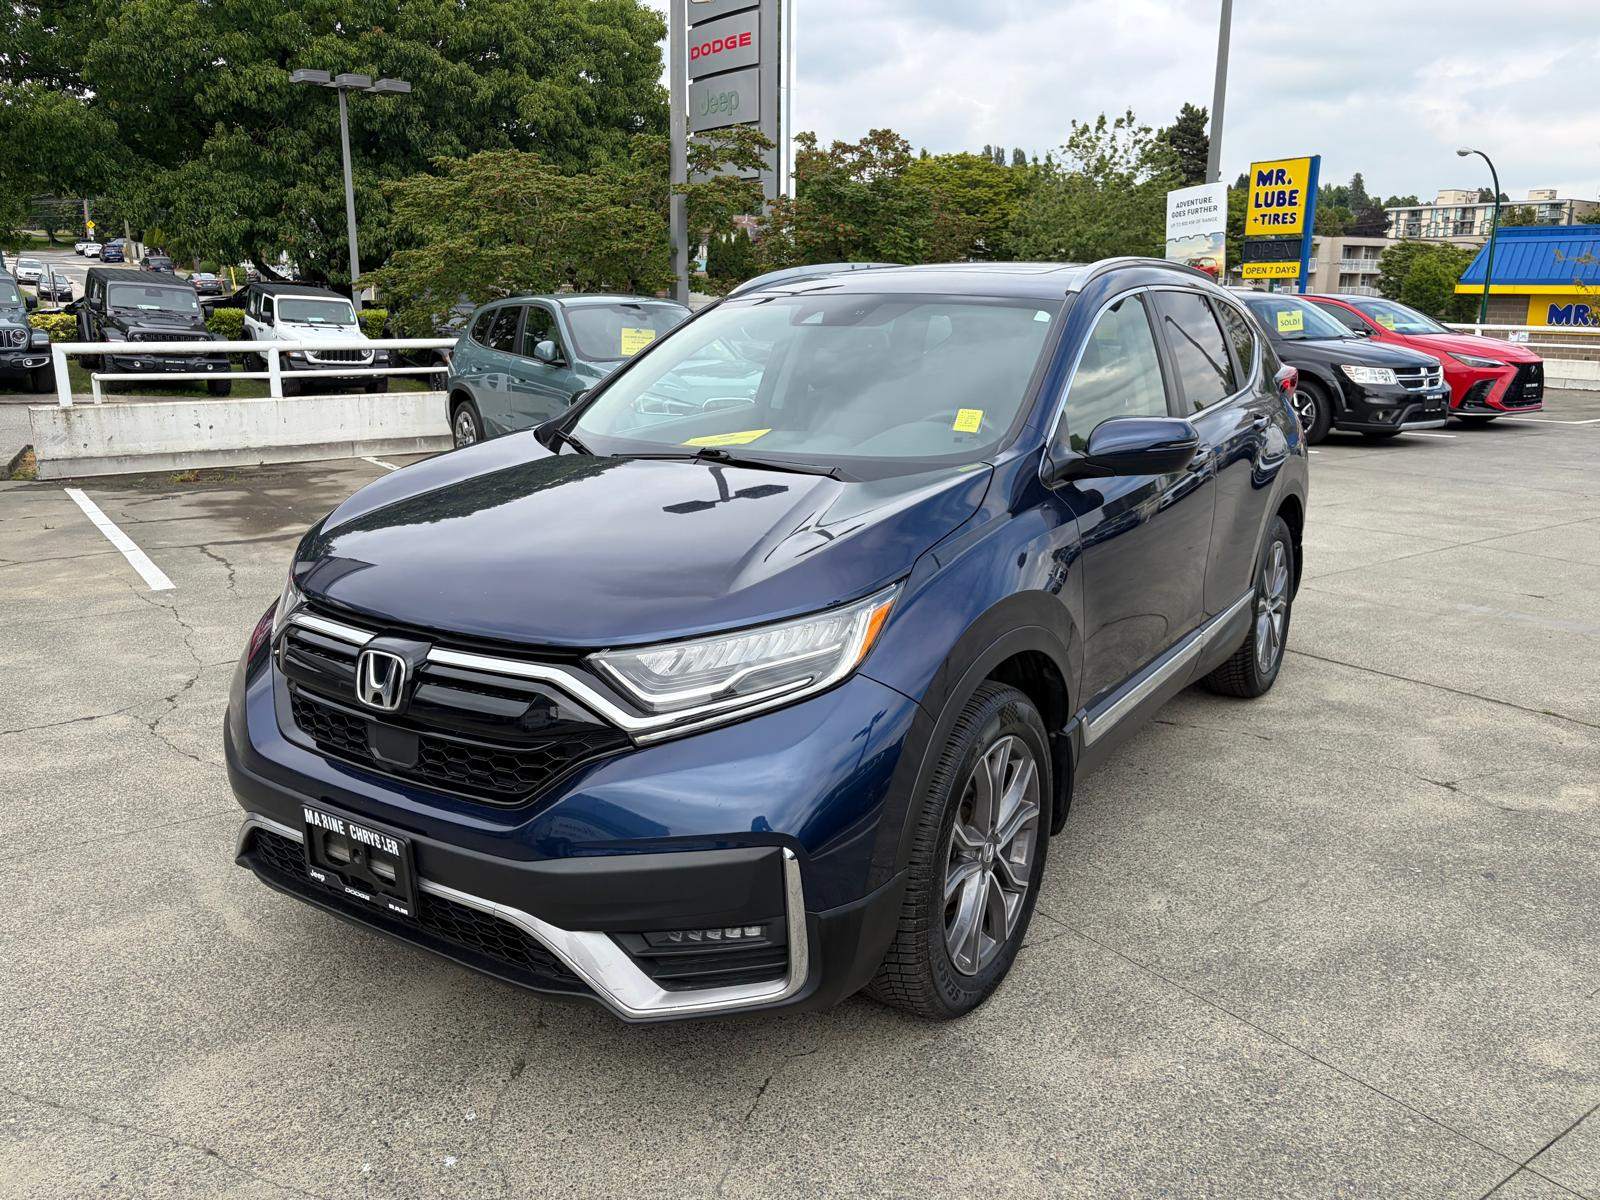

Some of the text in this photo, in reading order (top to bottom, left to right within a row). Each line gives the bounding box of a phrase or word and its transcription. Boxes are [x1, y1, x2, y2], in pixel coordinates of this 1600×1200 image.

[690, 32, 752, 61] DODGE
[700, 89, 740, 117] Jeep
[1256, 168, 1293, 187] MR.
[1176, 196, 1213, 209] ADVENTURE
[1254, 189, 1300, 209] LUBE
[1171, 205, 1218, 219] GOES FURTHER
[1245, 265, 1297, 275] OPEN 7 DAYS
[1280, 317, 1300, 327] SOLD!
[303, 807, 400, 857] MARINE CHRYSLER
[310, 868, 326, 882] Jeep
